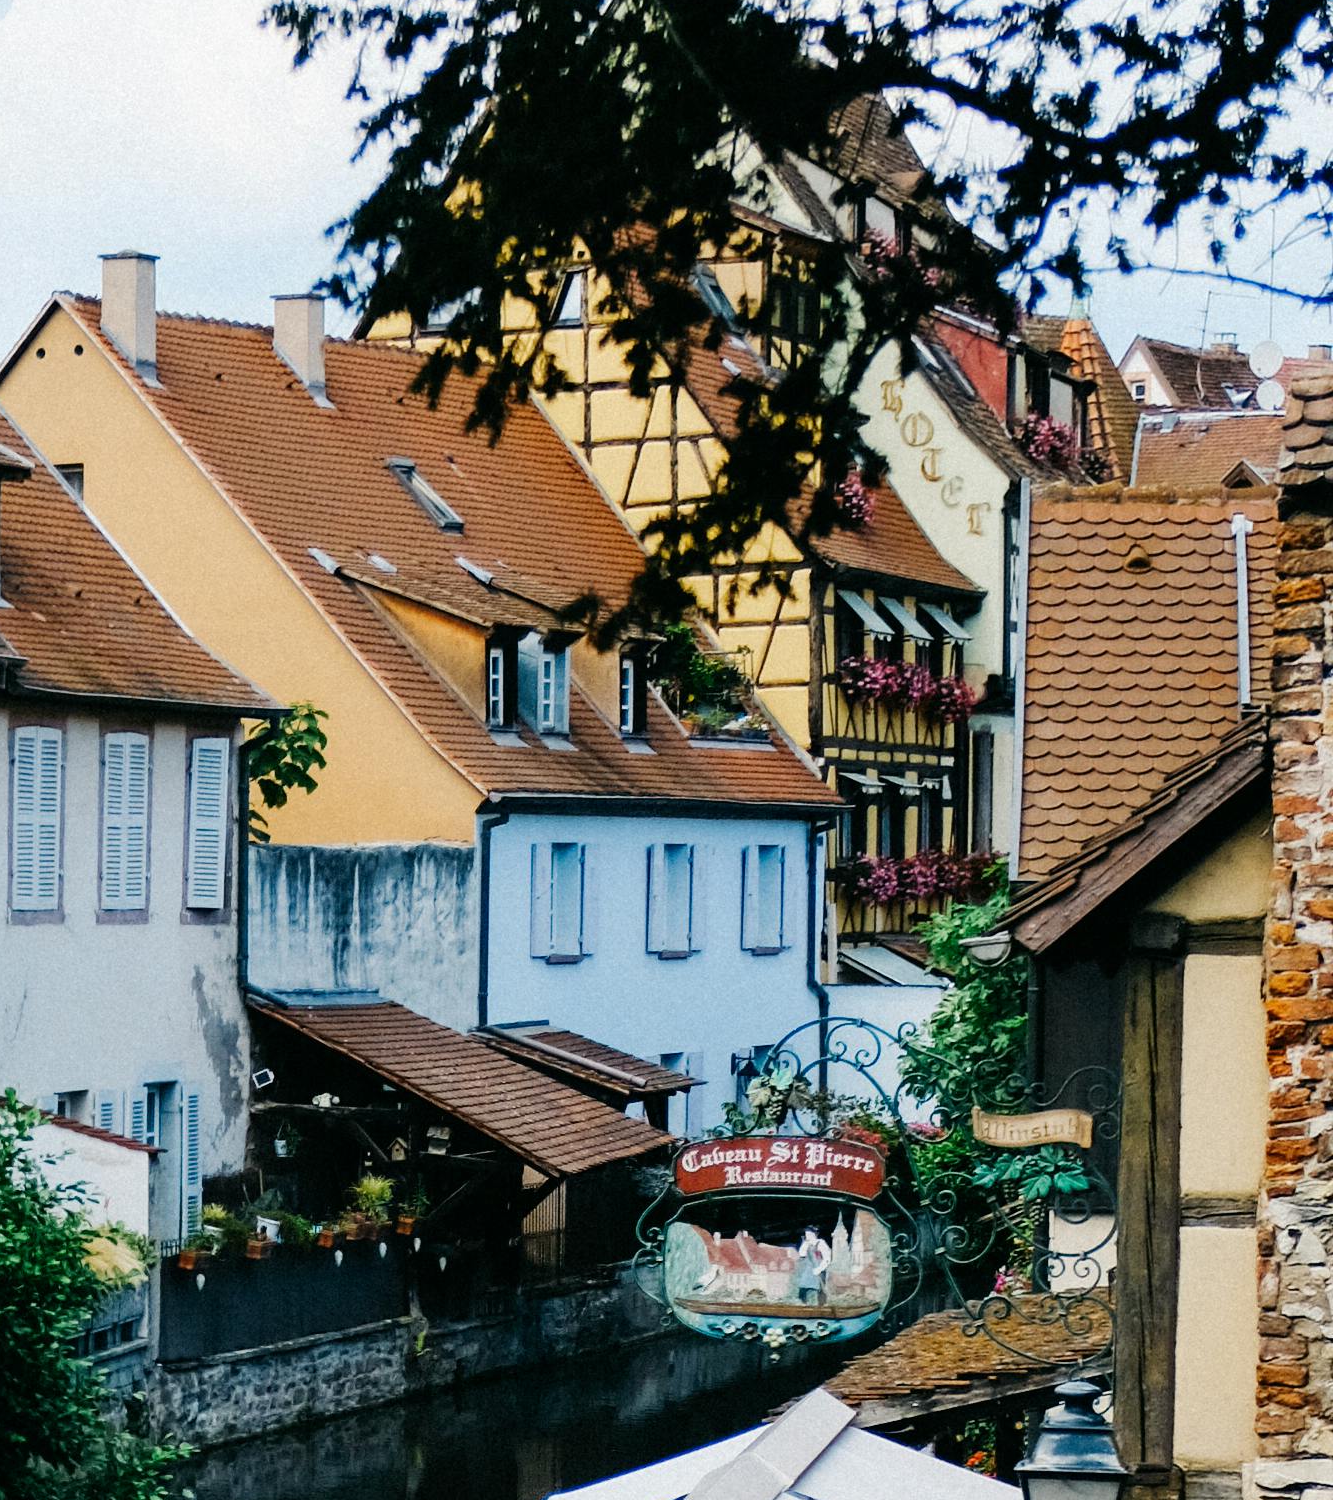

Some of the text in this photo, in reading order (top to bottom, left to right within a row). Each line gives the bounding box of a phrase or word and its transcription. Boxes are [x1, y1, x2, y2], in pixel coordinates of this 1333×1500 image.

[880, 379, 991, 536] HOTEL
[682, 1142, 875, 1173] Caveau St Pierre
[724, 1166, 833, 1187] Restaurant
